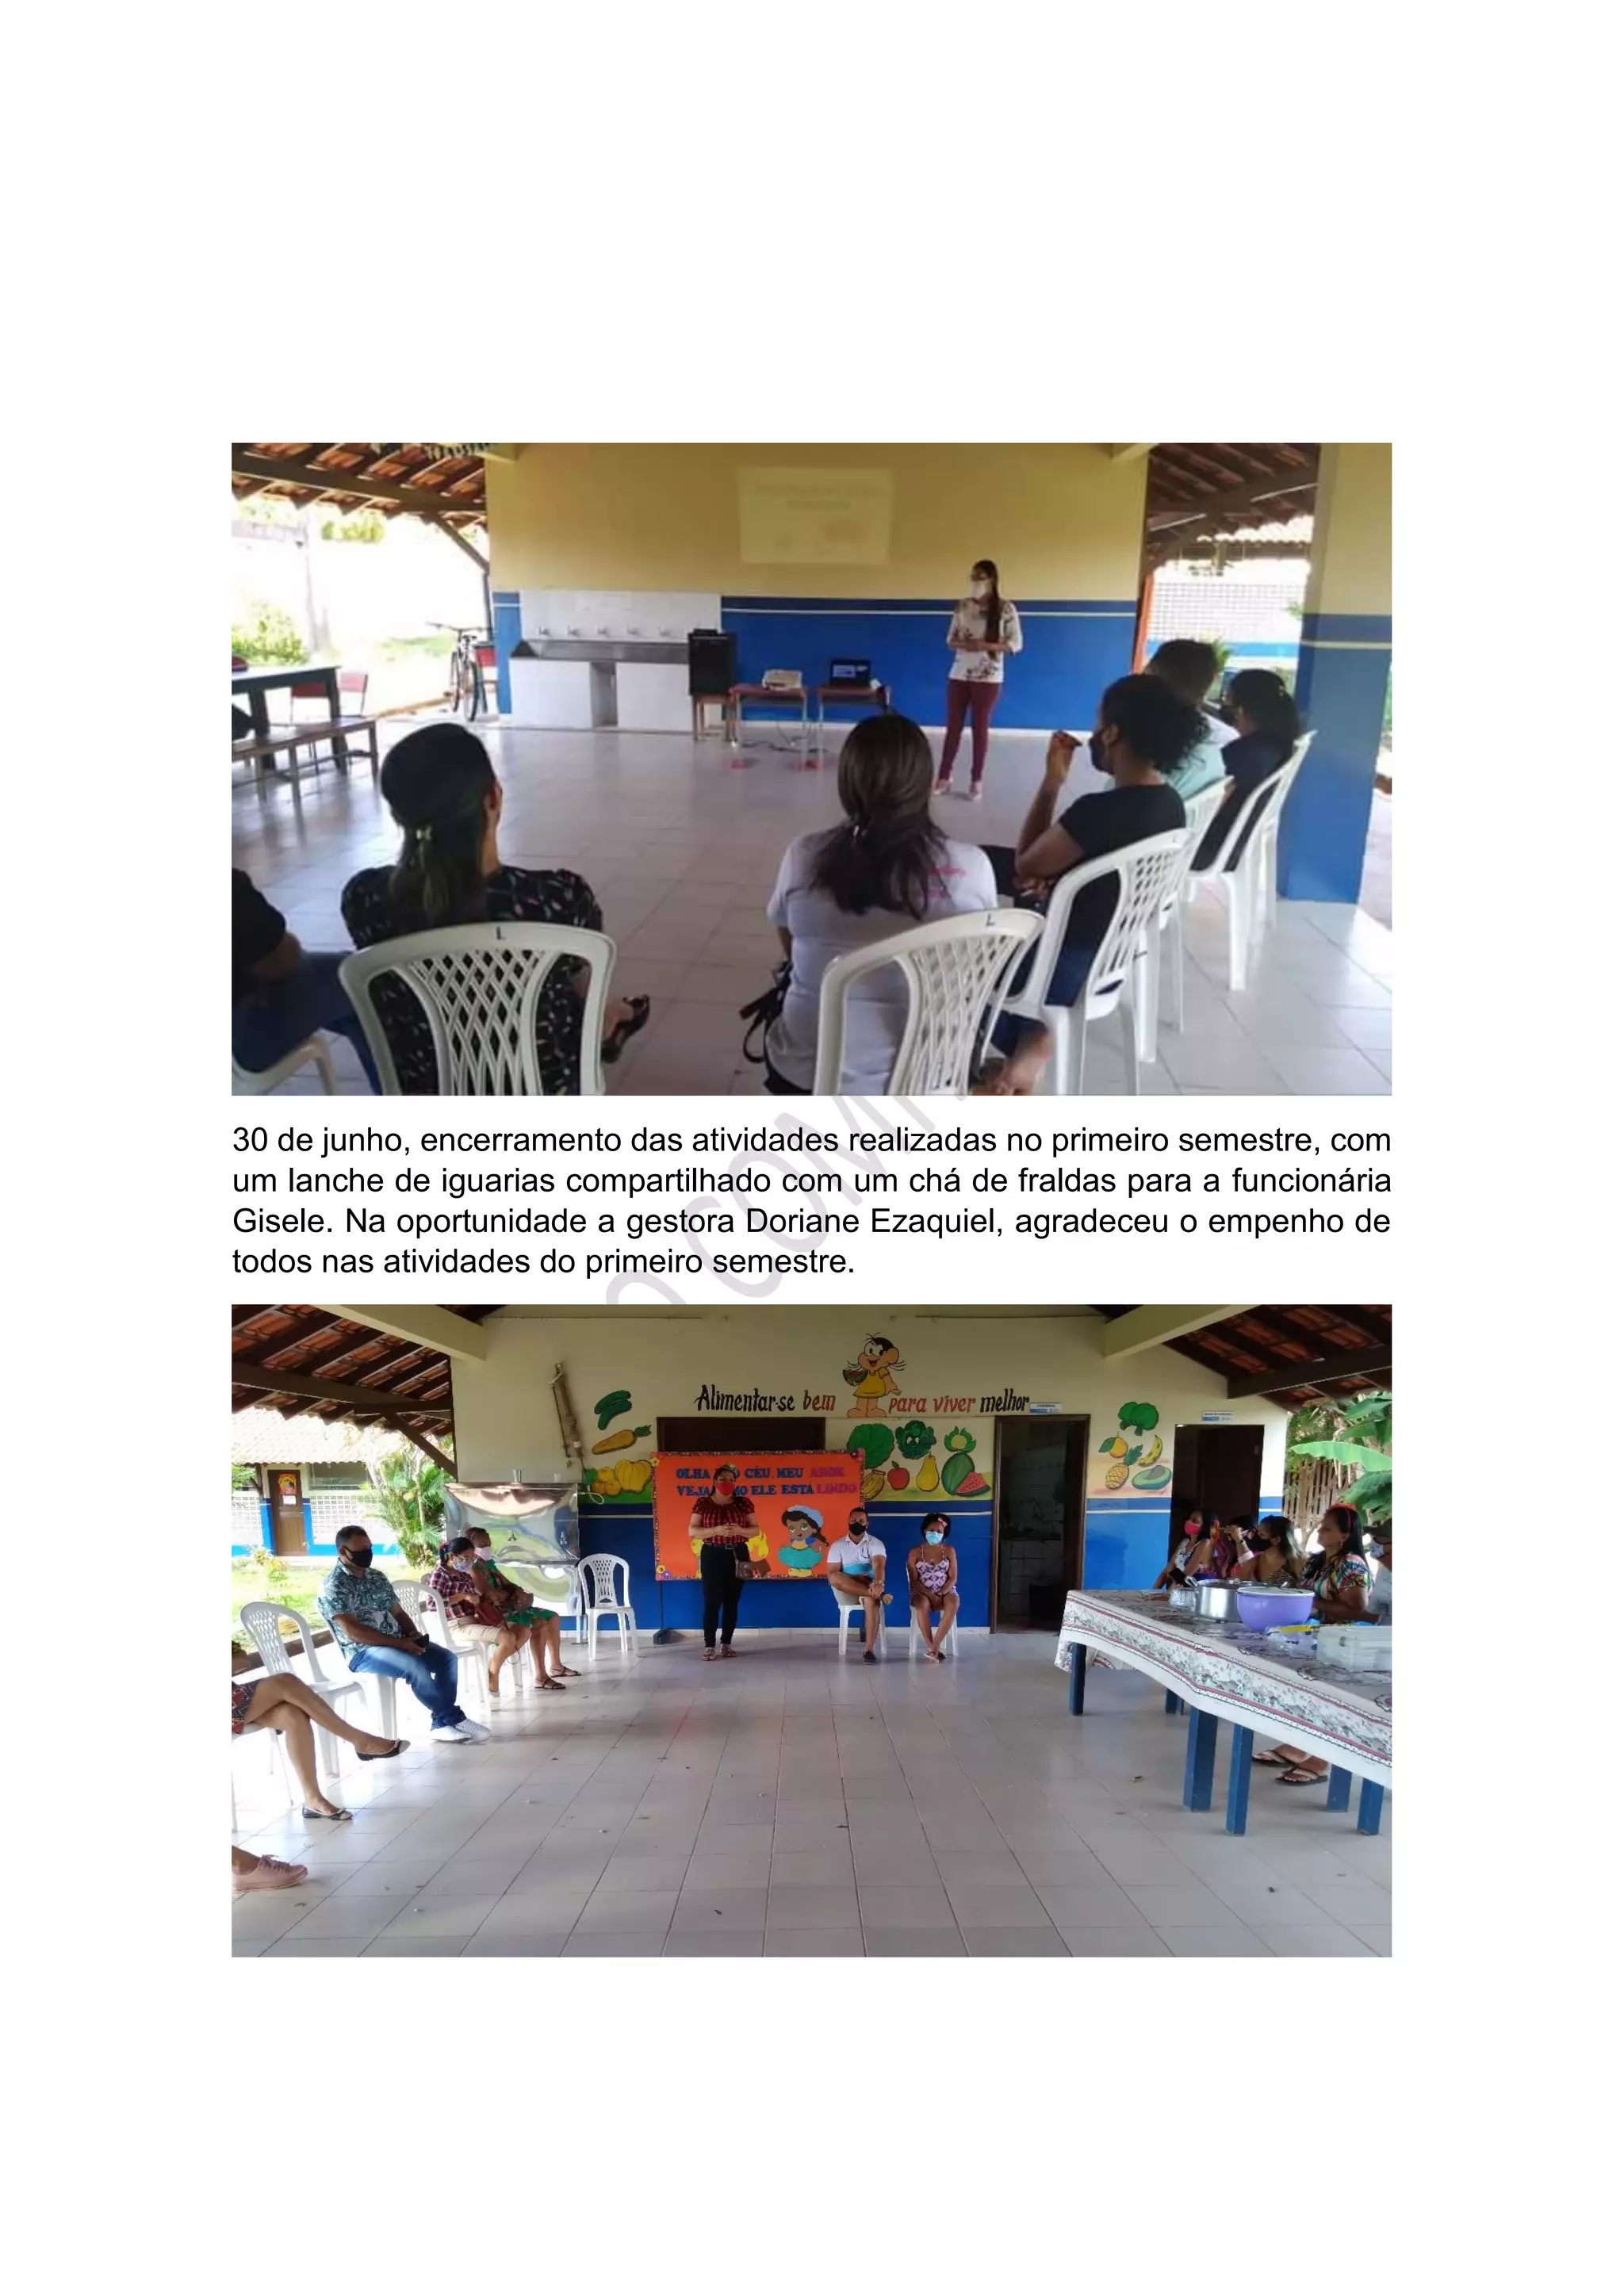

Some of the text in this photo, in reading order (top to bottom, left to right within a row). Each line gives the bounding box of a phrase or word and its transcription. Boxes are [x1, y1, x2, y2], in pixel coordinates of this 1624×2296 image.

[694, 1384, 1029, 1414] Alimentar-se bem para viver melhor
[676, 1468, 710, 1479] OLHA
[777, 1468, 803, 1479] MEU
[676, 1485, 710, 1496] VEJA
[751, 1485, 776, 1495] ELE
[817, 1483, 857, 1494] LINDO
